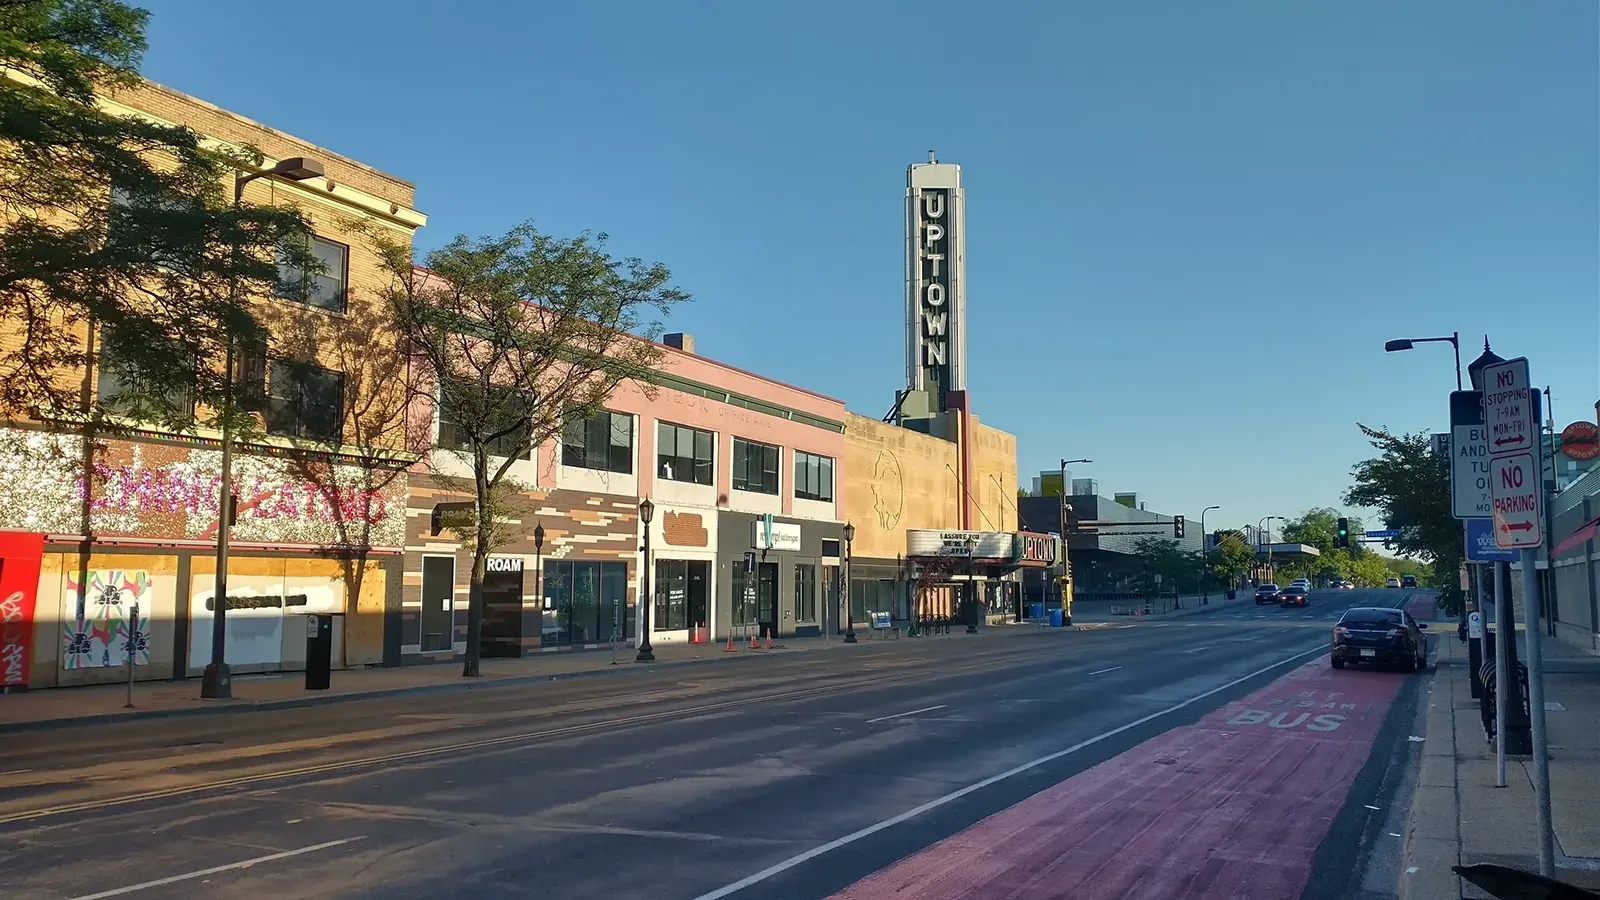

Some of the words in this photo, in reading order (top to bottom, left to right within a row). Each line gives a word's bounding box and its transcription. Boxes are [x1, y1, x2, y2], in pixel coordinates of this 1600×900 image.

[926, 194, 947, 365] UPTOWN
[1497, 370, 1514, 388] NO
[1487, 387, 1527, 406] STOPPING
[1496, 405, 1520, 420] 7-9AM
[1493, 420, 1526, 436] MON-FRI
[1566, 422, 1597, 434] UPTOWN
[1460, 445, 1486, 457] AND
[1568, 447, 1599, 458] UPTOWN
[1501, 465, 1523, 489] NO
[78, 462, 241, 516] CHINO
[252, 478, 386, 524] LATINO
[1495, 494, 1535, 514] PARKING
[1022, 536, 1054, 560] UPTOWN
[487, 558, 521, 572] ROAM
[1226, 709, 1347, 732] BUS
